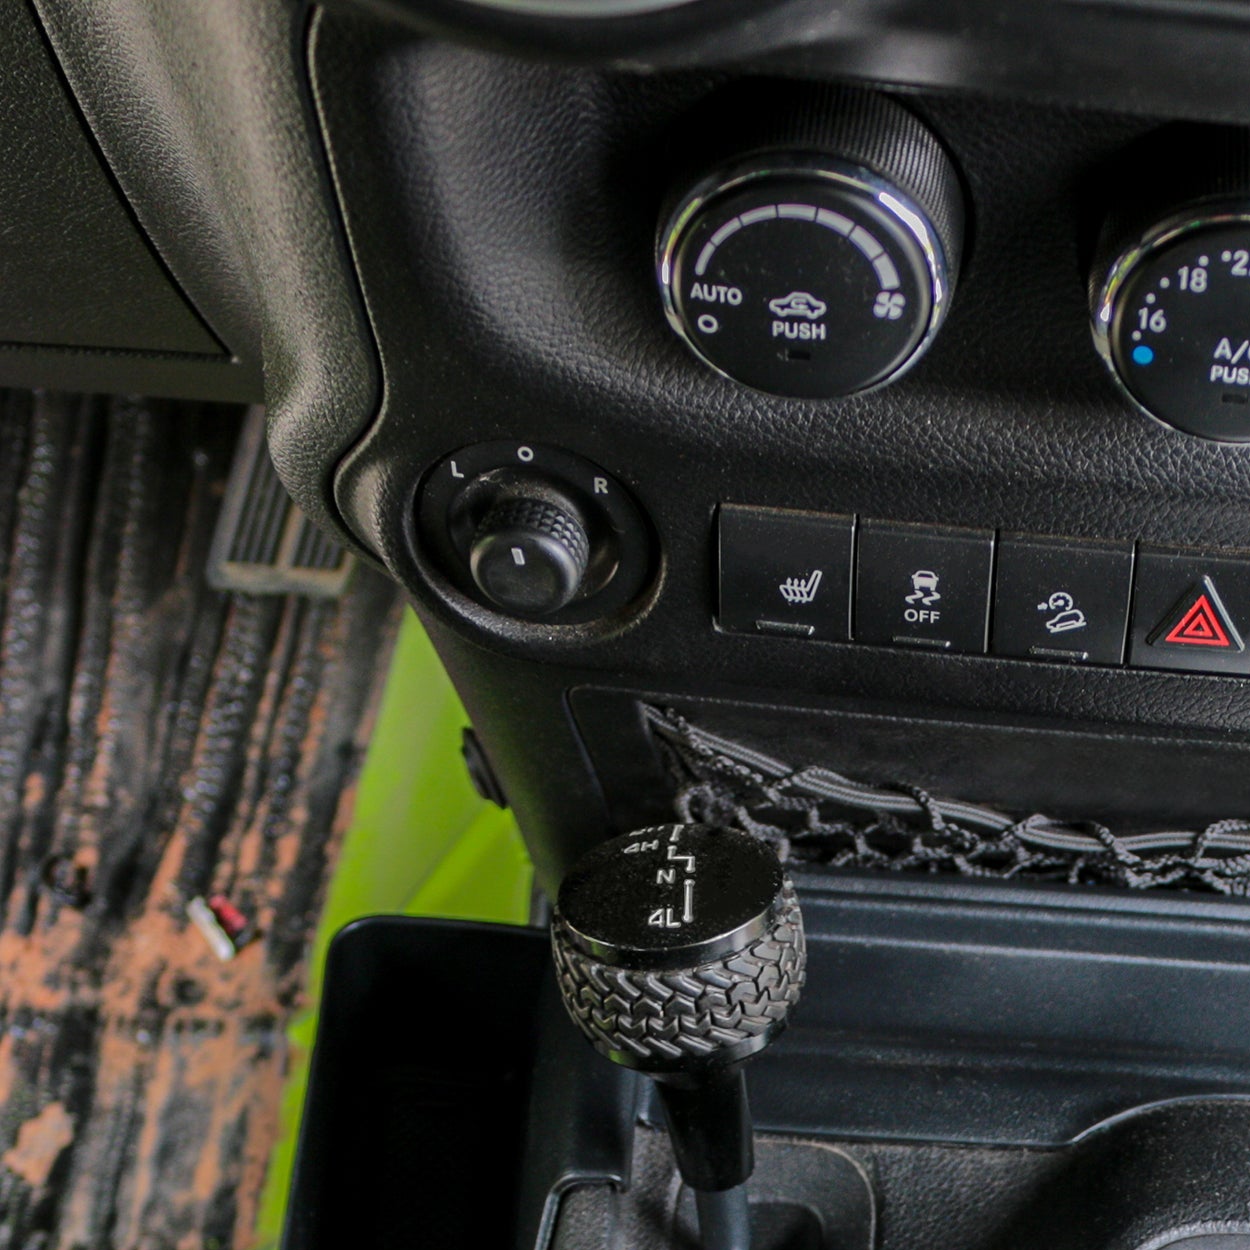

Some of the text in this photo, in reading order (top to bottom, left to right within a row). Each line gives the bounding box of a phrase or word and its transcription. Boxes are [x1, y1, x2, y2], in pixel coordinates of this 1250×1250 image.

[1178, 266, 1208, 293] 18
[690, 282, 743, 305] AUTO
[1138, 307, 1166, 332] 16
[772, 321, 826, 340] PUSH
[450, 460, 464, 478] L
[594, 477, 608, 493] R
[904, 609, 940, 624] OFF
[623, 839, 659, 854] 4H
[656, 868, 676, 884] N
[647, 908, 681, 928] 4L
